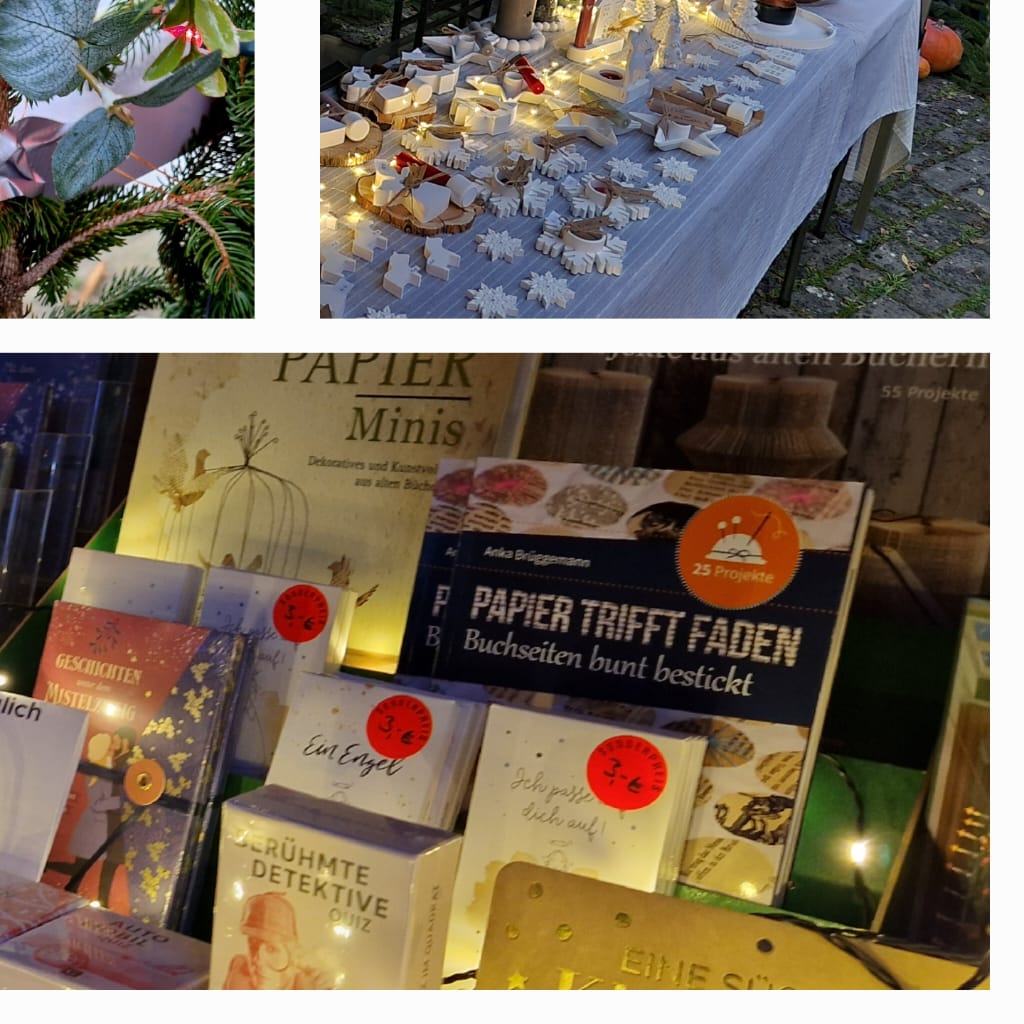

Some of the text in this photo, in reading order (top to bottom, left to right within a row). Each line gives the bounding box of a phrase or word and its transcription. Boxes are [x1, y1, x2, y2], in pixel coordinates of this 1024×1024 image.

[907, 385, 979, 402] Projekte
[345, 406, 466, 447] Minis
[369, 457, 389, 472] und
[483, 544, 513, 561] Anka
[692, 562, 775, 585] 25 Projekte
[470, 584, 804, 669] PAPIER TRIFFT FADEN
[55, 652, 144, 686] GESCHICHTEN
[463, 628, 755, 698] Buchseiten bunt bestickt
[302, 733, 405, 778] Ein Engel
[250, 858, 391, 920] DETEKTIVE
[328, 906, 374, 933] QUIZ
